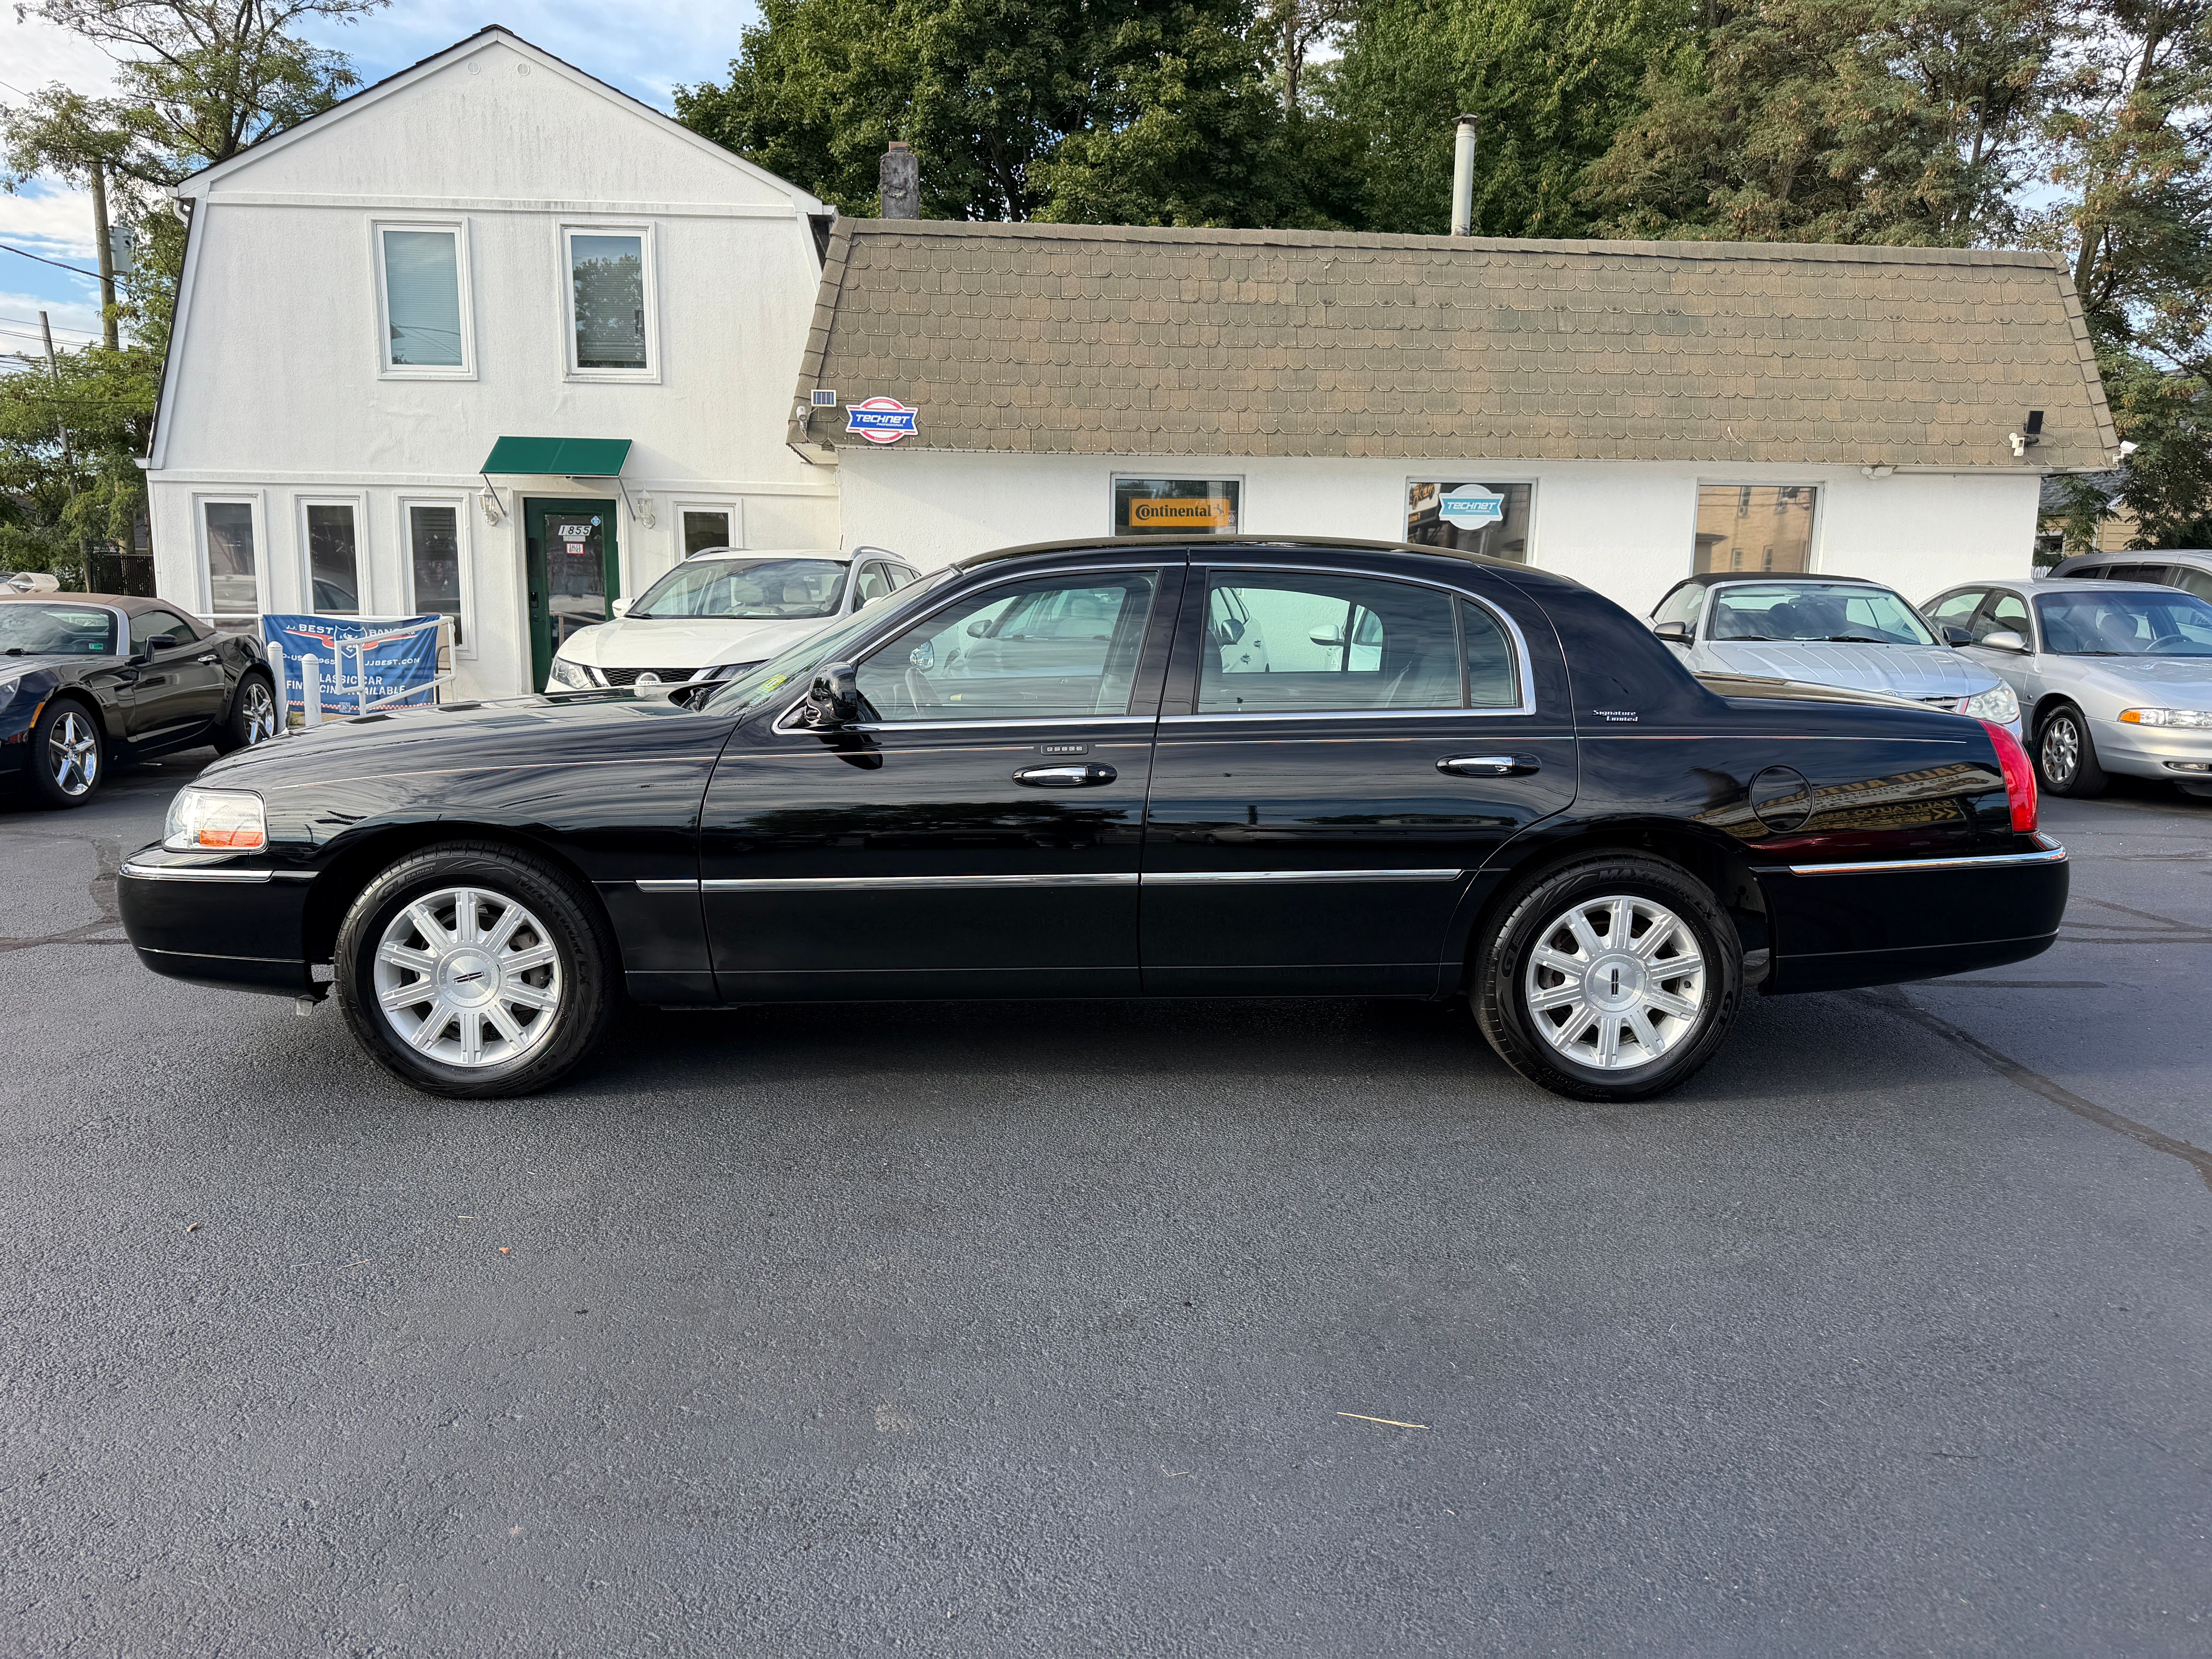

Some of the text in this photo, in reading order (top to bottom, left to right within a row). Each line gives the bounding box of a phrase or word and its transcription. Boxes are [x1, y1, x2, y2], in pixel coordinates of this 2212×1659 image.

[856, 414, 910, 424] TECHNET
[1135, 504, 1211, 520] Continental
[561, 526, 590, 534] 1855
[299, 623, 334, 634] BEST
[364, 658, 420, 666] JJBEST.COM
[405, 867, 434, 879] RADIAL
